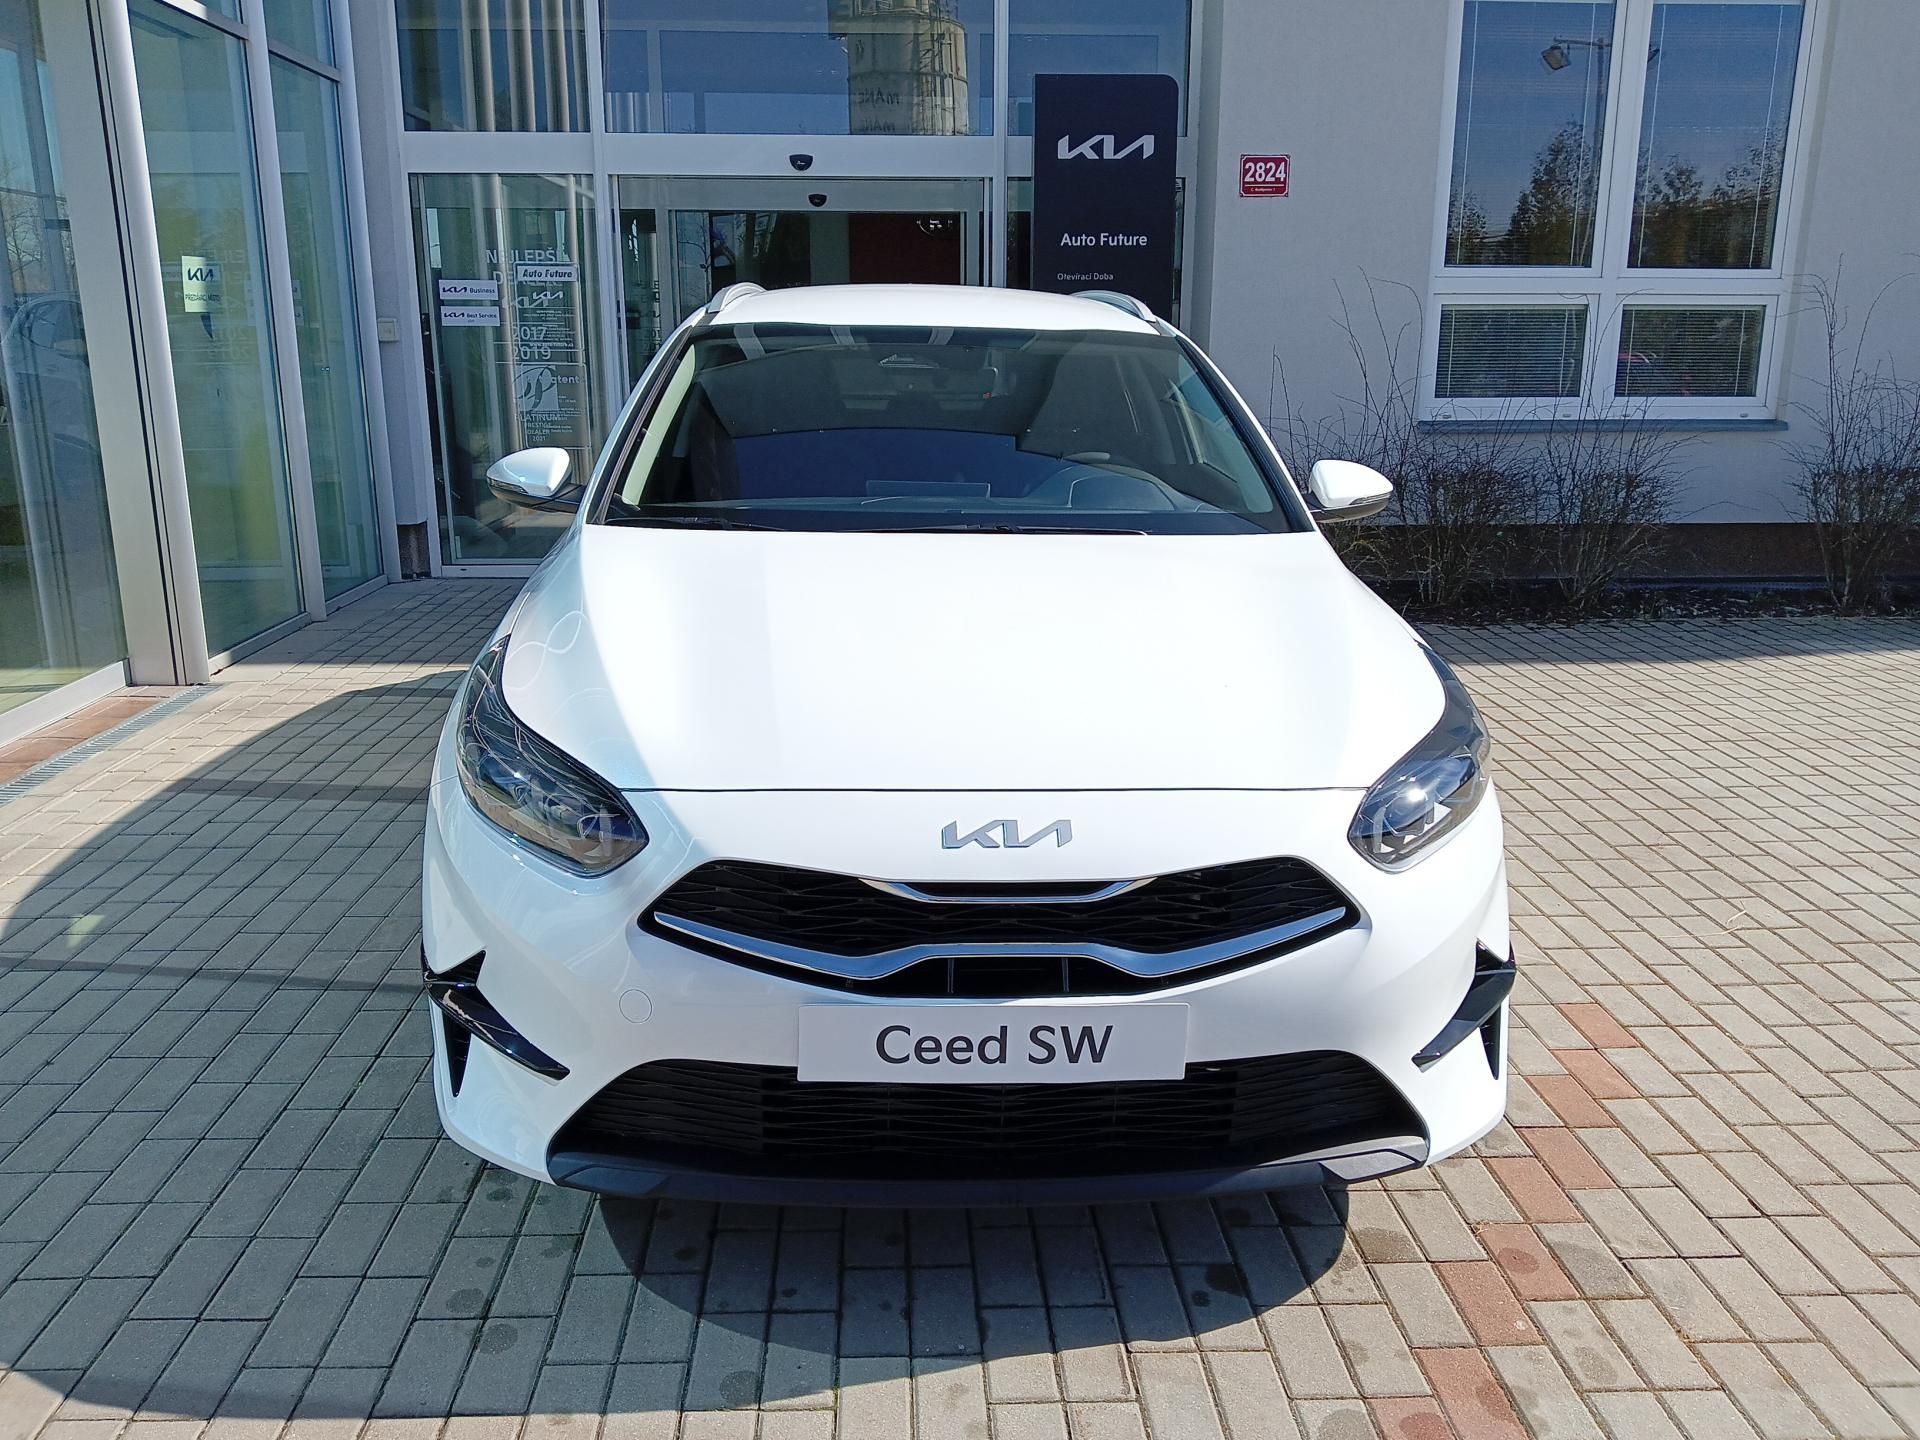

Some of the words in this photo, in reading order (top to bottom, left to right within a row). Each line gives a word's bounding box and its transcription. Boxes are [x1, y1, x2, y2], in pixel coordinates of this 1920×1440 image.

[1057, 134, 1155, 160] KIA
[1244, 161, 1286, 182] 2824
[1060, 233, 1096, 247] Auto
[1099, 233, 1148, 247] Future
[188, 268, 213, 281] KIA
[522, 268, 543, 278] Auto
[544, 268, 573, 279] Future
[1093, 272, 1114, 281] Doba
[533, 291, 563, 299] KIA
[513, 346, 551, 360] 2019
[941, 819, 1073, 849] KIA
[875, 1025, 1008, 1064] Ceed
[1028, 1025, 1114, 1064] SW
